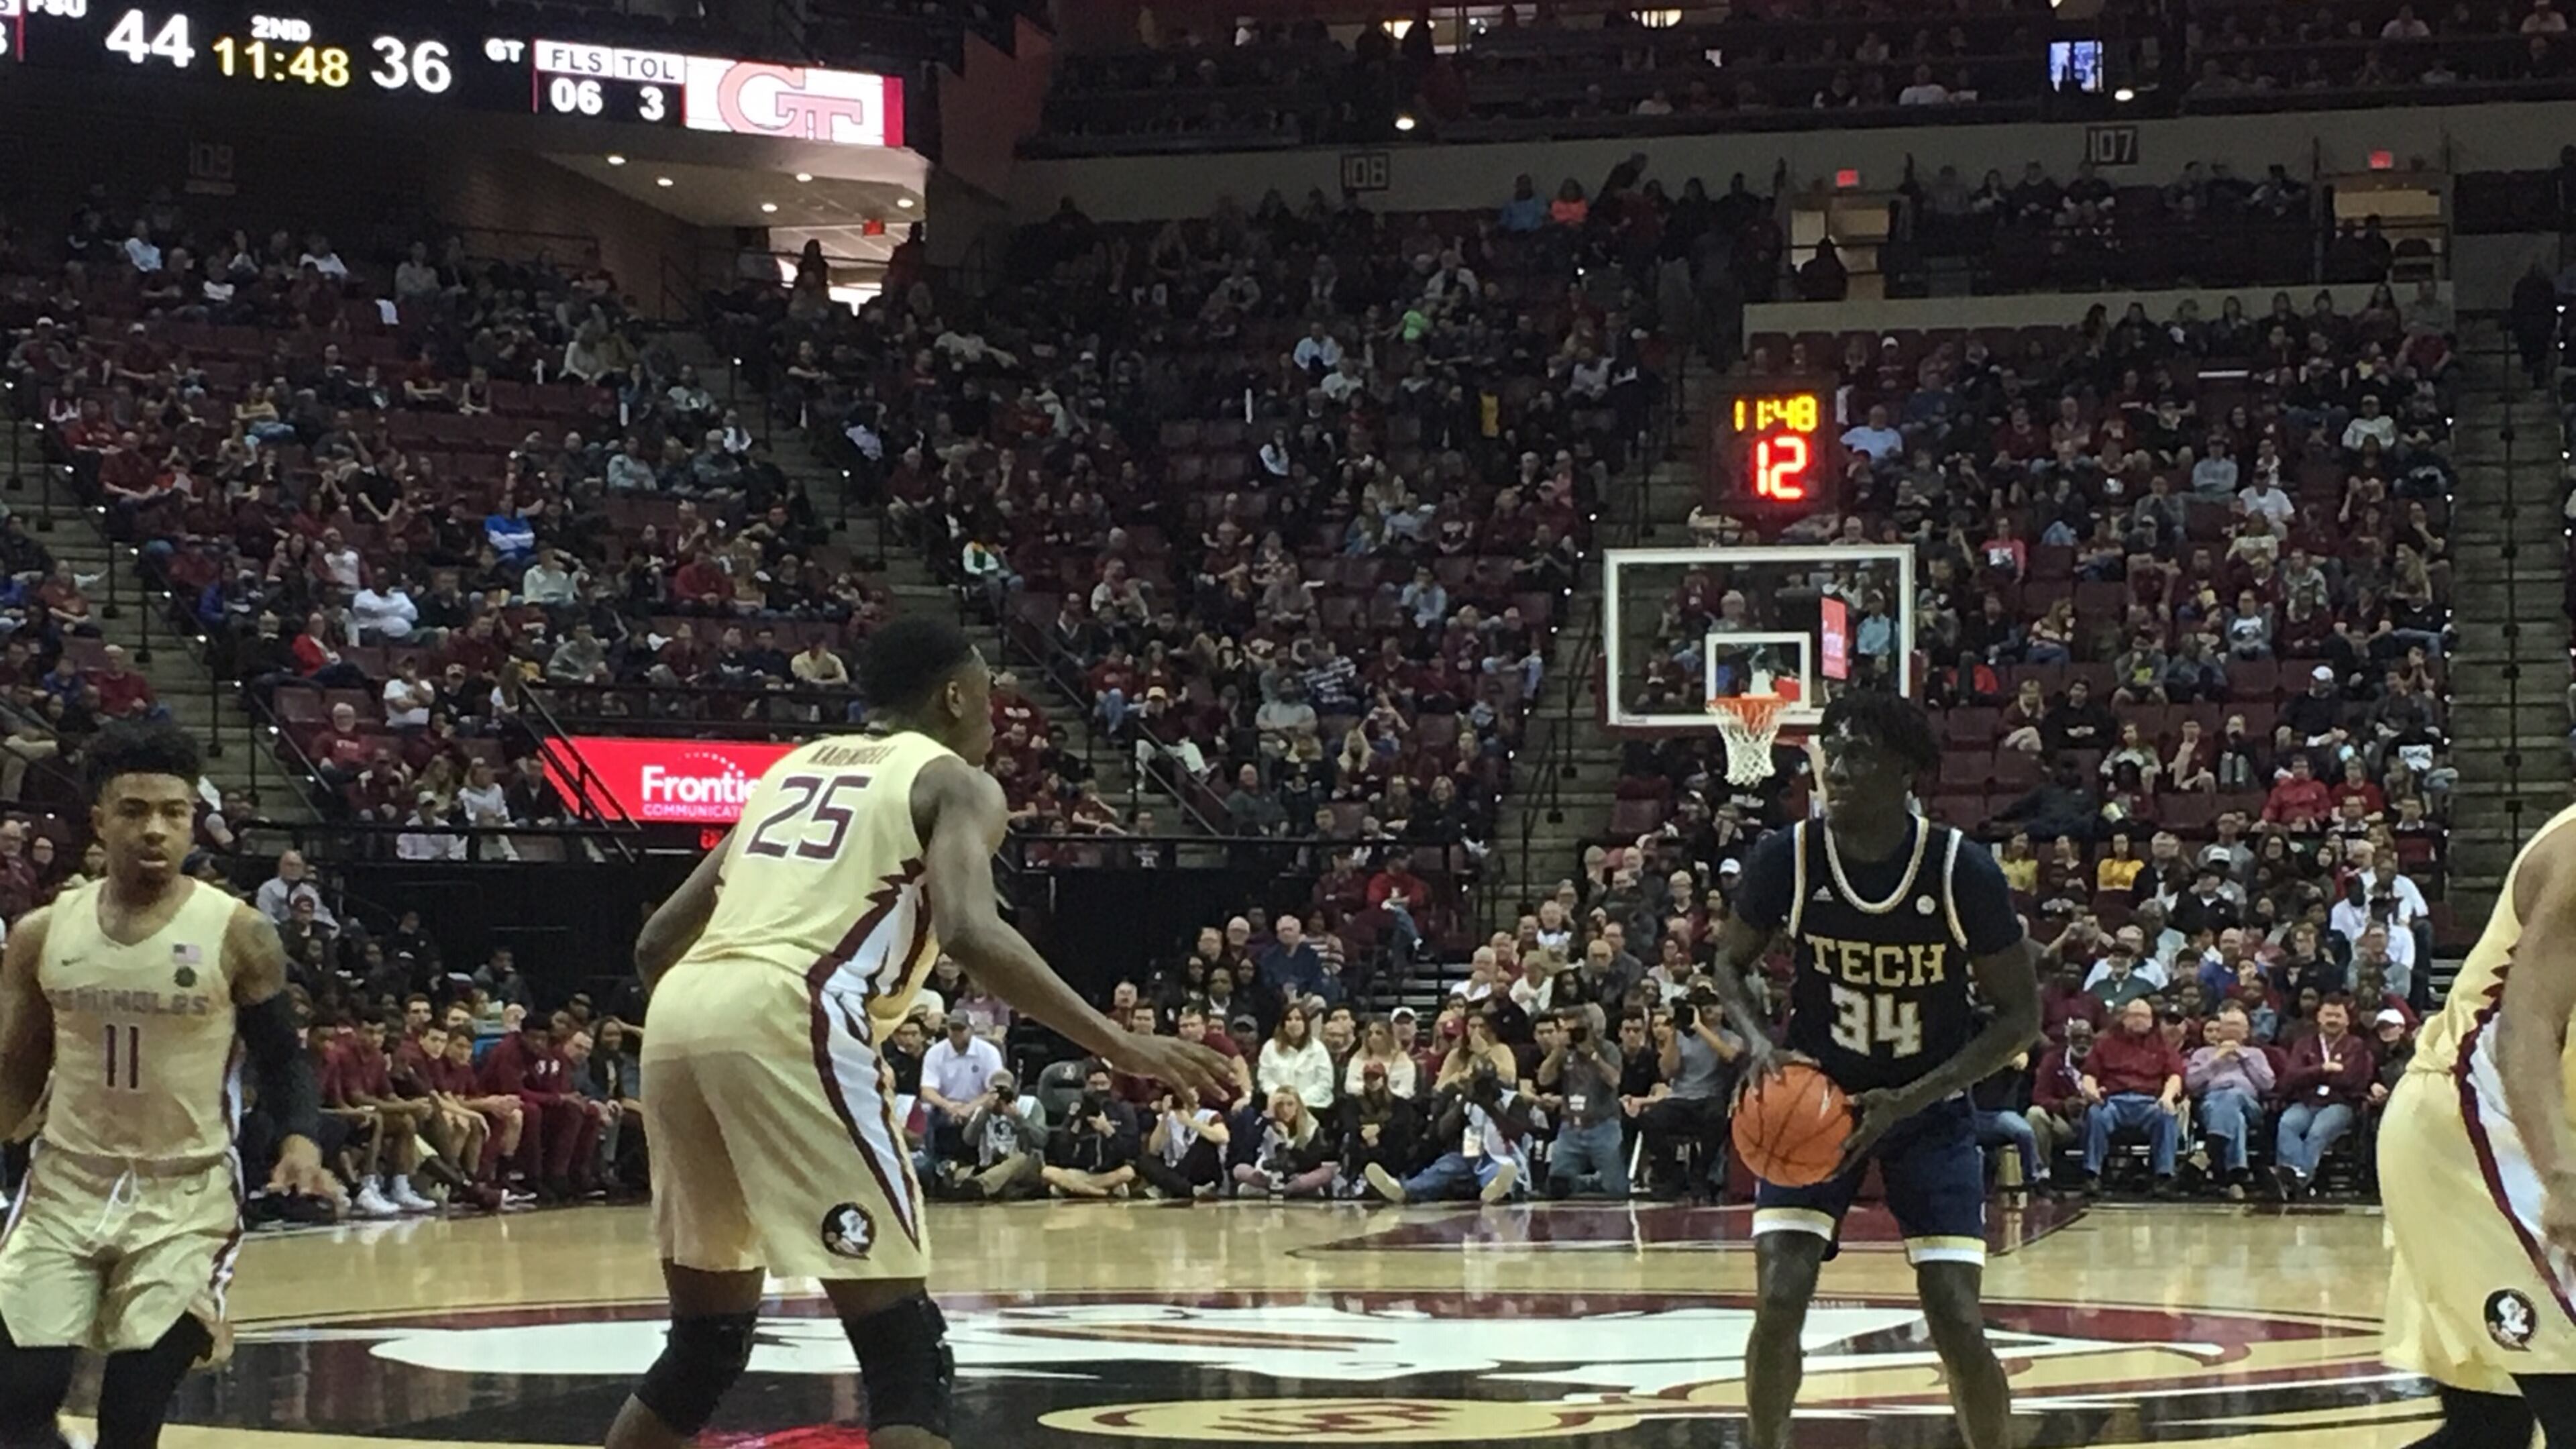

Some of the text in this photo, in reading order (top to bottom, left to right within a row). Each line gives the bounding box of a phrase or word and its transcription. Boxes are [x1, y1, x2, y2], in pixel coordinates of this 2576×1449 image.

[105, 9, 195, 68] 44
[251, 15, 312, 42] 2ND
[484, 38, 525, 63] GT
[213, 37, 350, 87] 11:48
[371, 36, 451, 93] 36
[551, 49, 676, 80] FLS TOL
[549, 77, 665, 121] 06 3
[2090, 129, 2134, 162] 107
[1735, 394, 1817, 432] 11:48
[1757, 437, 1806, 499] 12
[745, 775, 873, 861] 25
[1804, 932, 1947, 987] TECH
[1829, 983, 1922, 1059] 34
[103, 1023, 140, 1089] 11
